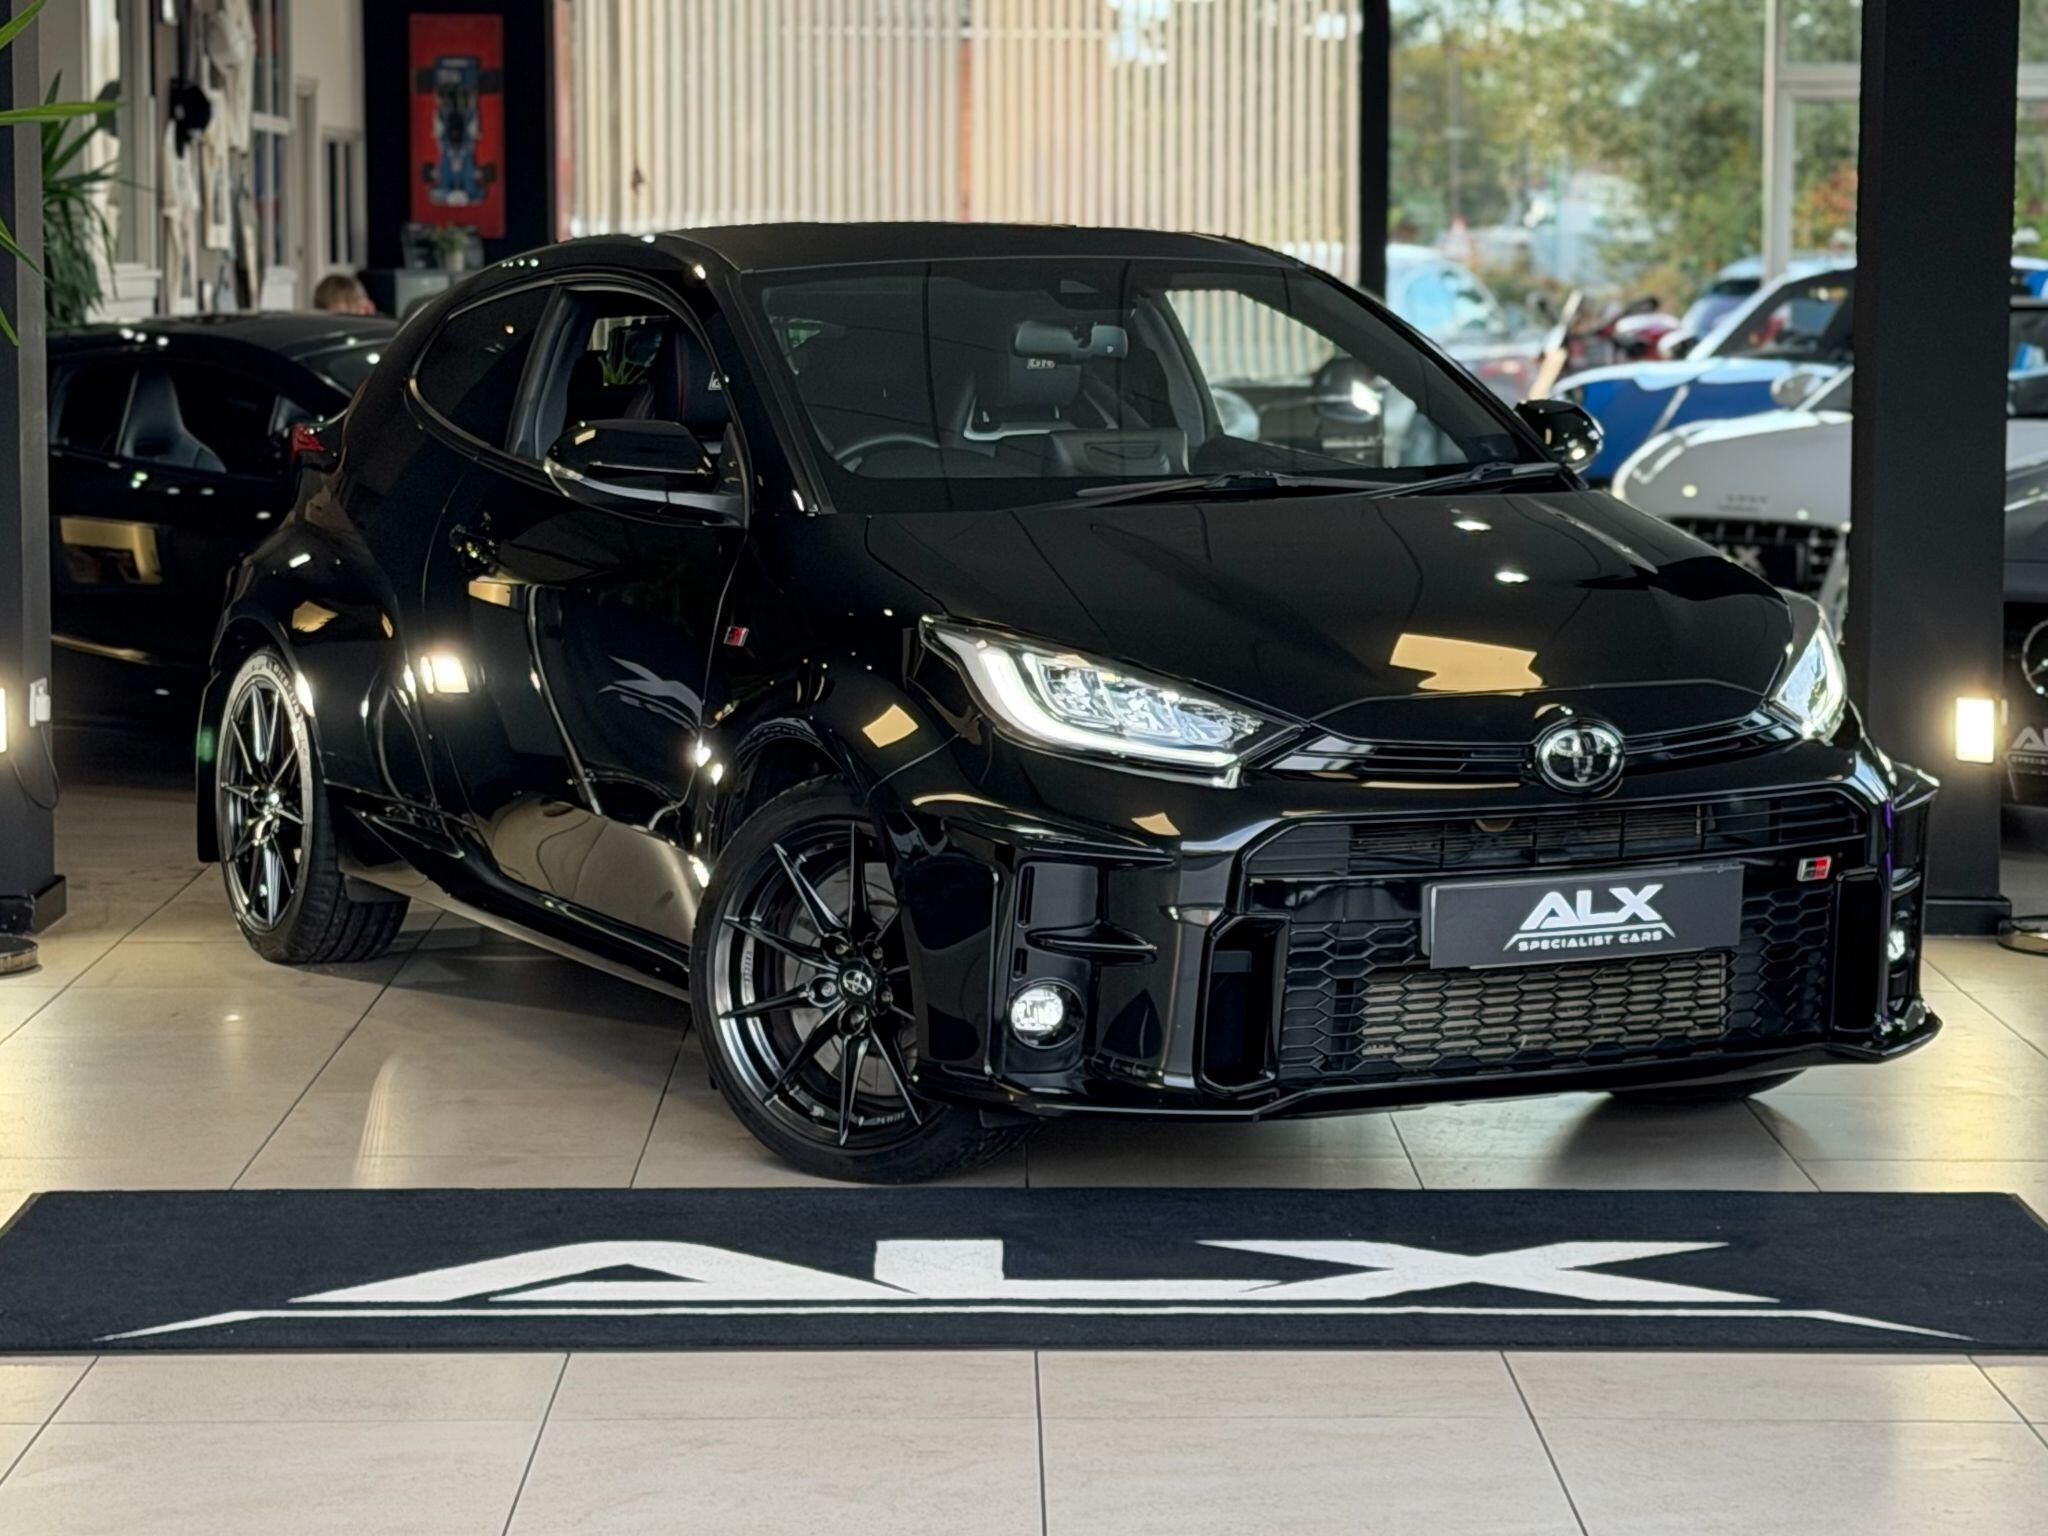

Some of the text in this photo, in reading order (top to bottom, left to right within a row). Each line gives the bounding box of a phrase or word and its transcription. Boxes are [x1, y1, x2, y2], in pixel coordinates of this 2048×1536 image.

[1519, 883, 1664, 931] ALX
[1517, 930, 1663, 952] SPECIALIST CARS
[286, 1239, 1780, 1303] ALX
